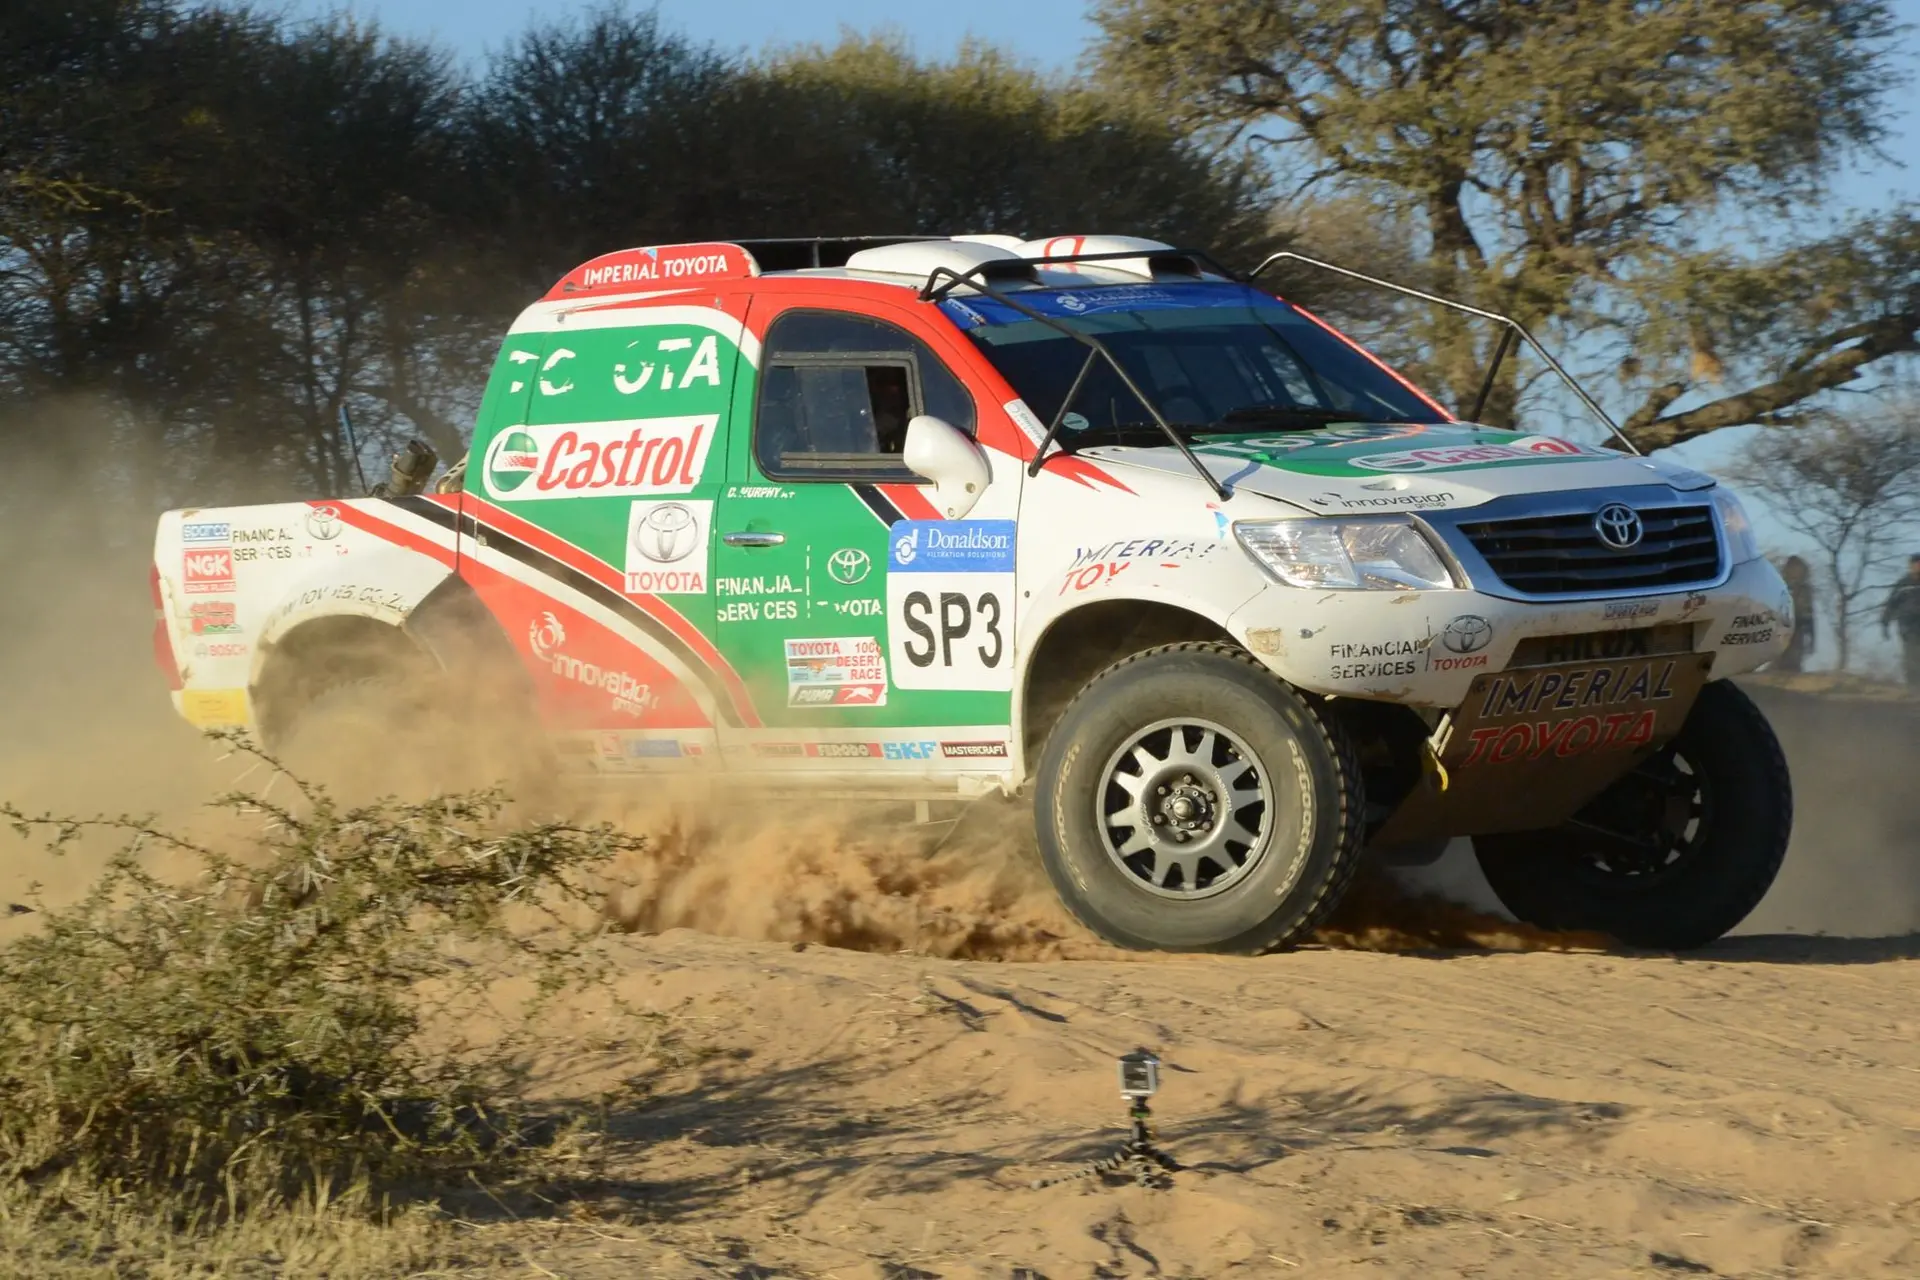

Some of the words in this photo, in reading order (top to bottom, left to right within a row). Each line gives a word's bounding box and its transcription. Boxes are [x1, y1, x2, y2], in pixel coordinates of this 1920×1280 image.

[583, 261, 660, 286] IMPERIAL
[663, 254, 728, 278] TOYOTA
[508, 335, 721, 396] TOOTA
[536, 423, 705, 491] Castrol
[1341, 490, 1455, 508] innovation
[1415, 500, 1447, 510] group
[232, 528, 294, 543] FINANCA
[926, 527, 1008, 549] Donaldson
[233, 546, 293, 561] SERCES
[186, 554, 230, 578] NGK
[628, 572, 704, 591] TOYOTA
[716, 600, 798, 622] SERVCES
[816, 598, 884, 617] YOTA
[903, 590, 1003, 669] SP3
[1721, 628, 1773, 645] SERVICES
[790, 642, 841, 656] TOYOTA
[835, 655, 881, 667] DESERT
[1331, 660, 1416, 679] SERVICES
[1433, 655, 1488, 671] TOYOTA
[850, 668, 882, 680] RACE
[1479, 660, 1677, 719] IMPERIAL
[1459, 709, 1658, 768] TOYOTA
[883, 741, 937, 760] SKF
[943, 745, 1005, 756] MASTERCRAFT
